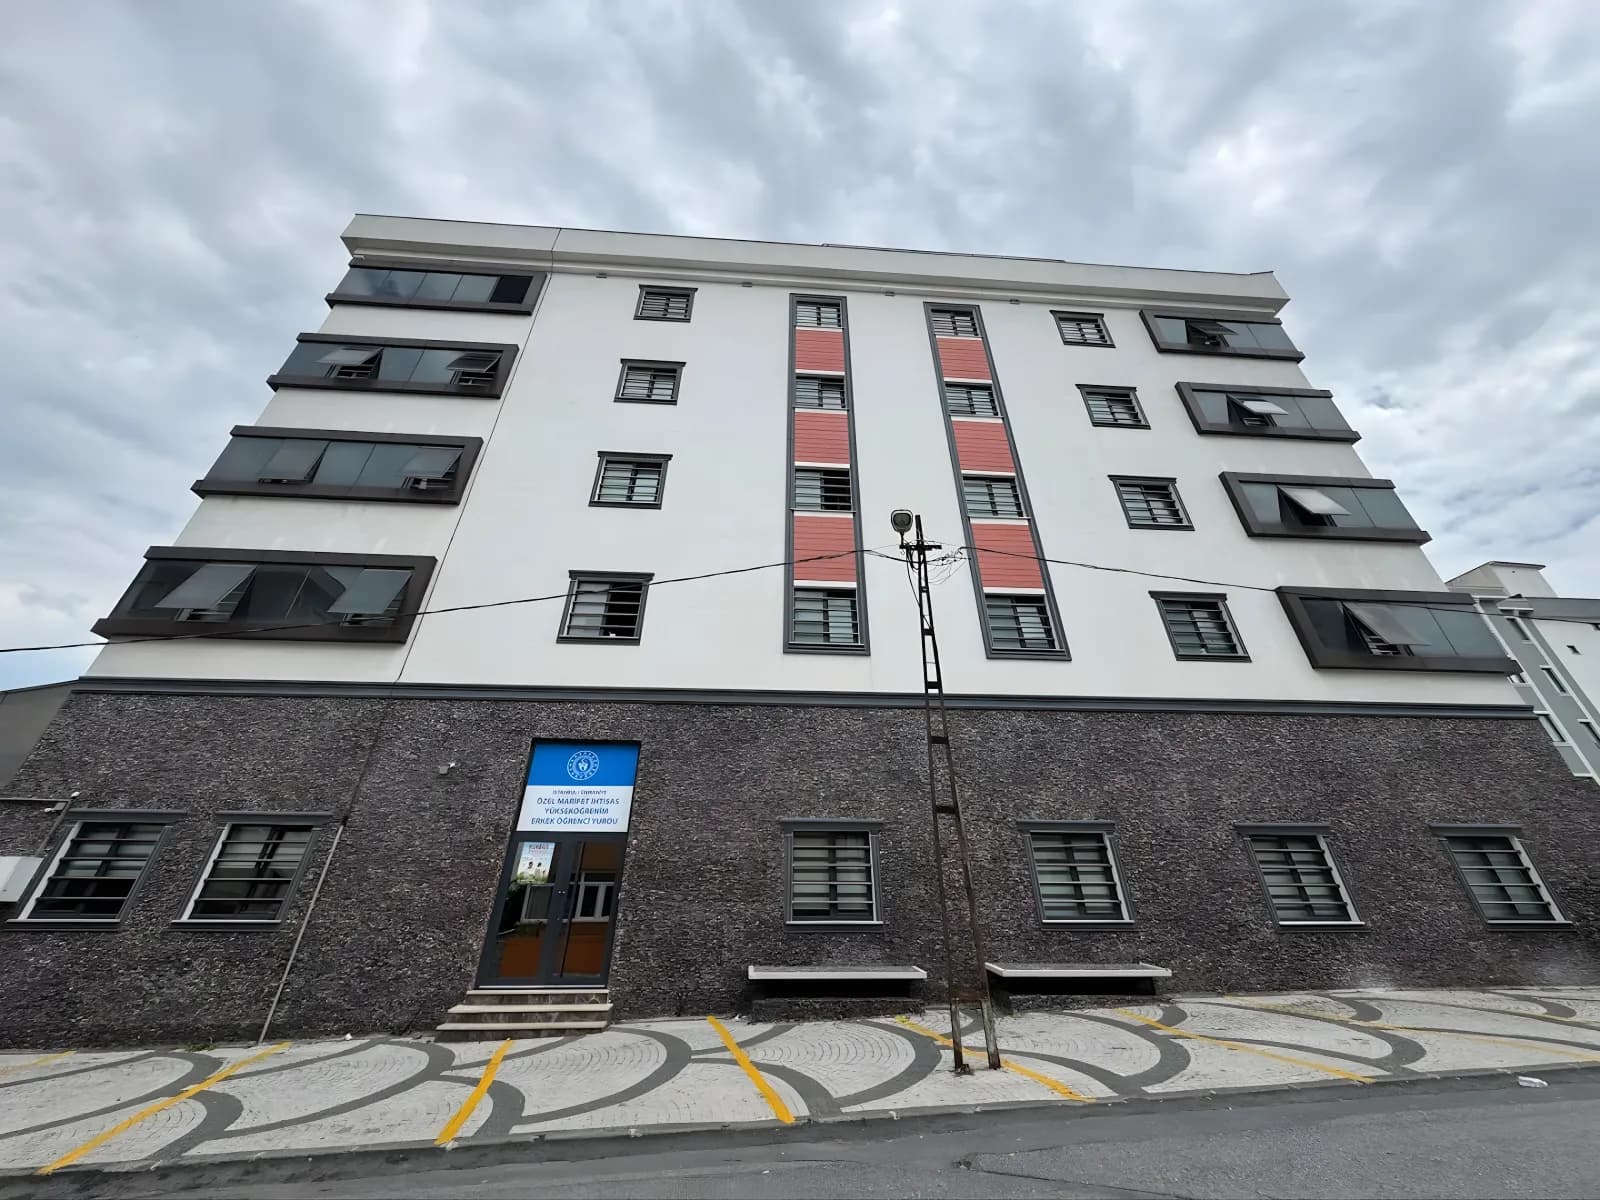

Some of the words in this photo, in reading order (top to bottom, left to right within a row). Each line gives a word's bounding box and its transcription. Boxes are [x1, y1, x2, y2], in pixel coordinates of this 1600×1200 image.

[537, 797, 555, 805] ÖZEL
[531, 817, 555, 825] ERKEK
[592, 817, 618, 825] YURDU
